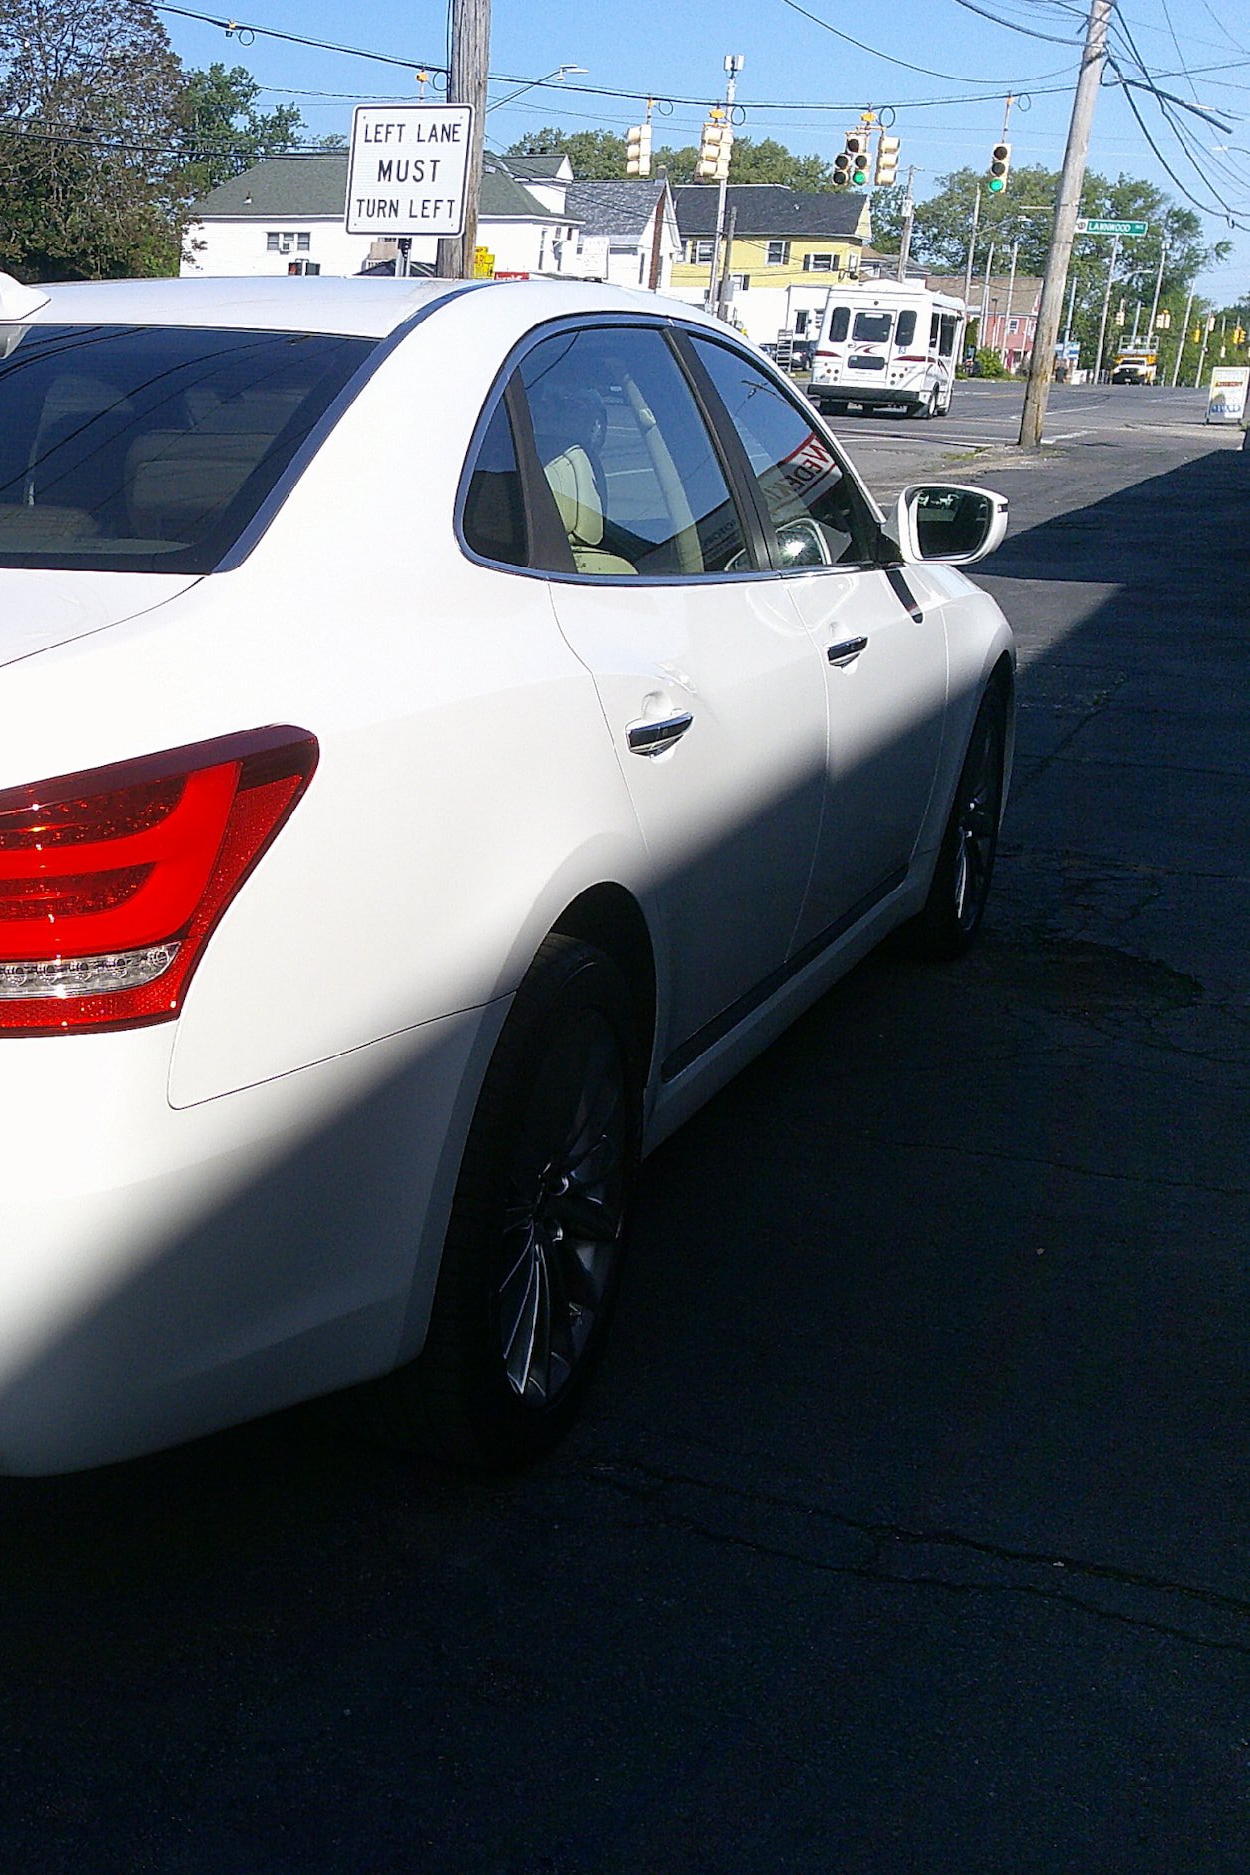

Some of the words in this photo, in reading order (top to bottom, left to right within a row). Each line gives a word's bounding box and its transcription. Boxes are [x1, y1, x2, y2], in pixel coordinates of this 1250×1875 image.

[364, 123, 406, 143] LEFT
[416, 123, 462, 143] LANE
[377, 159, 441, 183] MUST
[356, 198, 399, 218] TURN
[408, 199, 456, 219] LEFT
